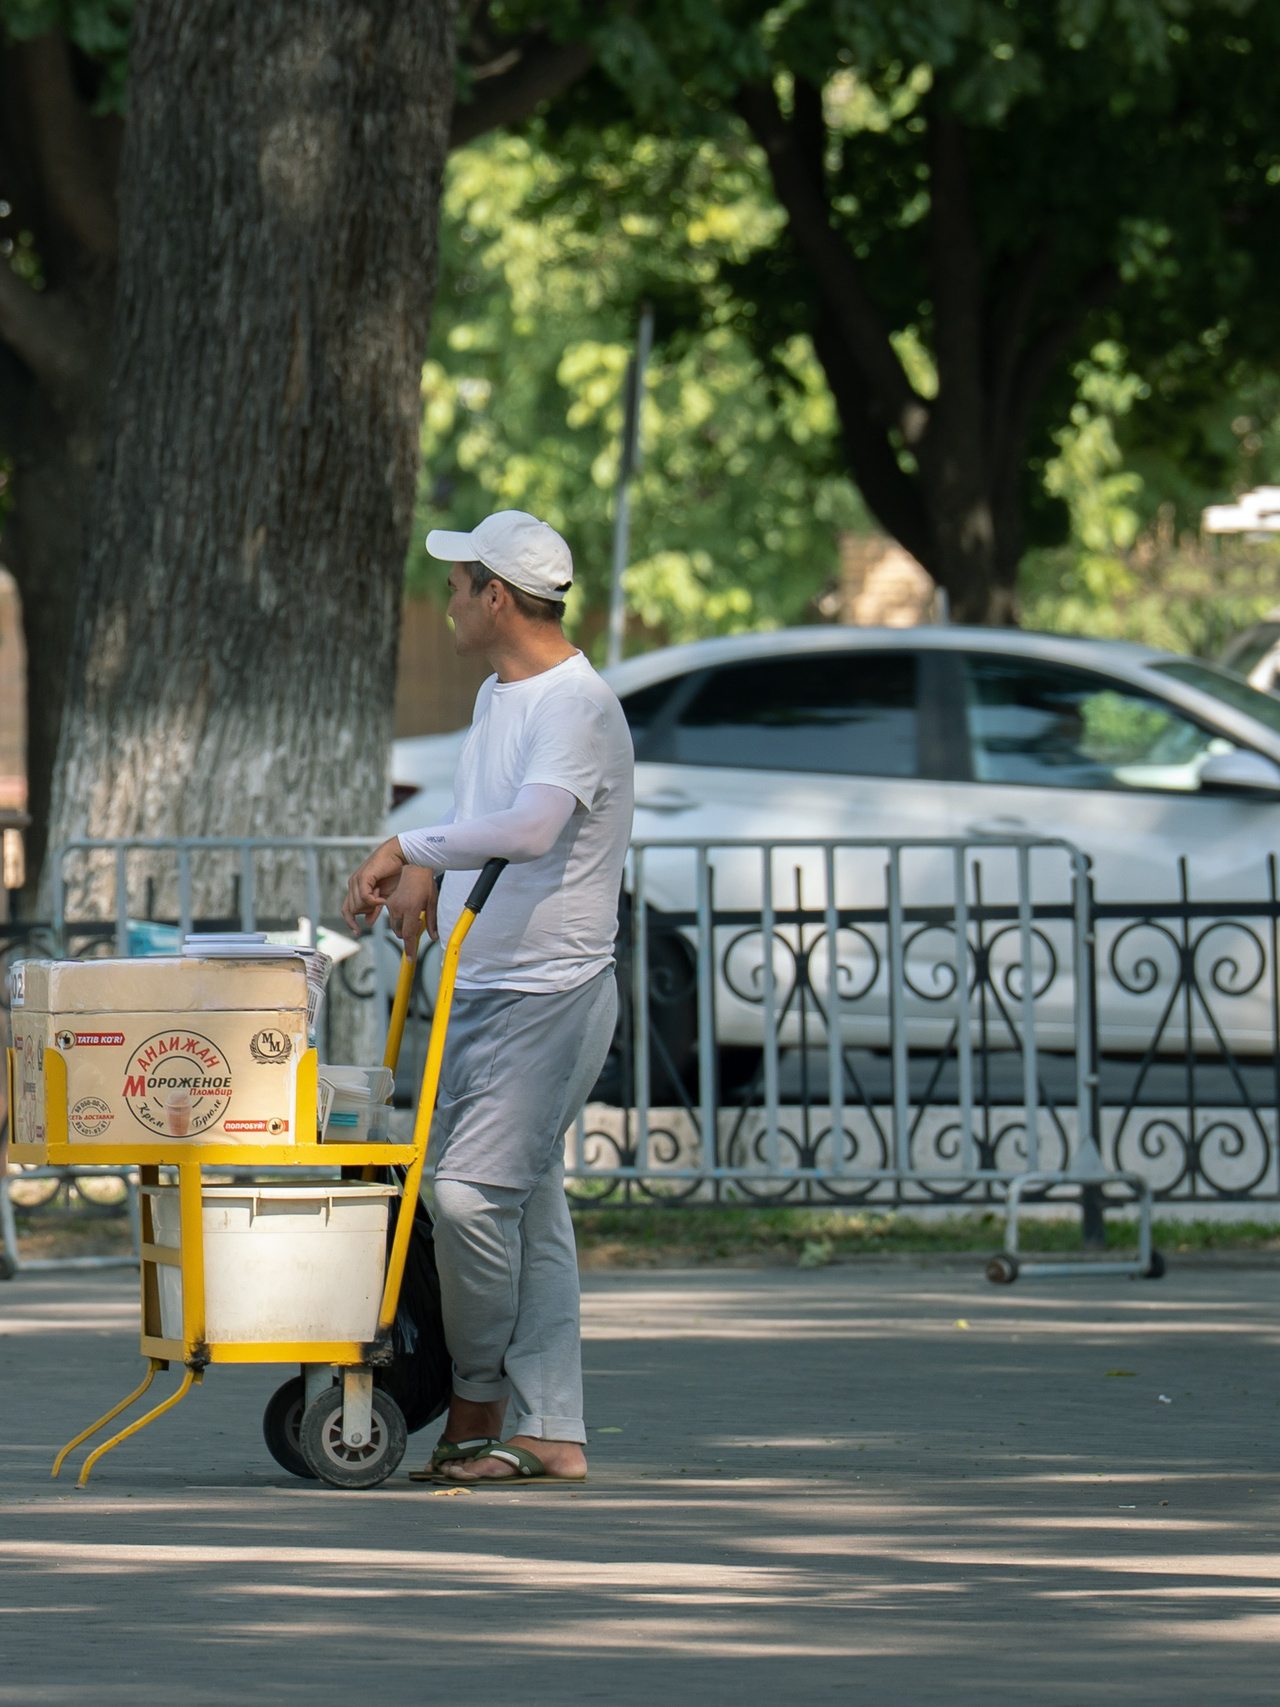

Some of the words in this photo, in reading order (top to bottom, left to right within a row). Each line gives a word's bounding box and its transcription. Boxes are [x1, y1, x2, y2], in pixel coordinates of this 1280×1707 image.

[77, 1036, 99, 1044] TATIB
[101, 1036, 123, 1044] KO'R!
[137, 1036, 220, 1072] АНДИЖАН
[122, 1075, 232, 1097] МОРОЖЕНОЕ
[189, 1088, 232, 1097] Пломбир
[136, 1101, 164, 1129] Крем
[225, 1121, 266, 1130] ПОПРОБУЙ!
